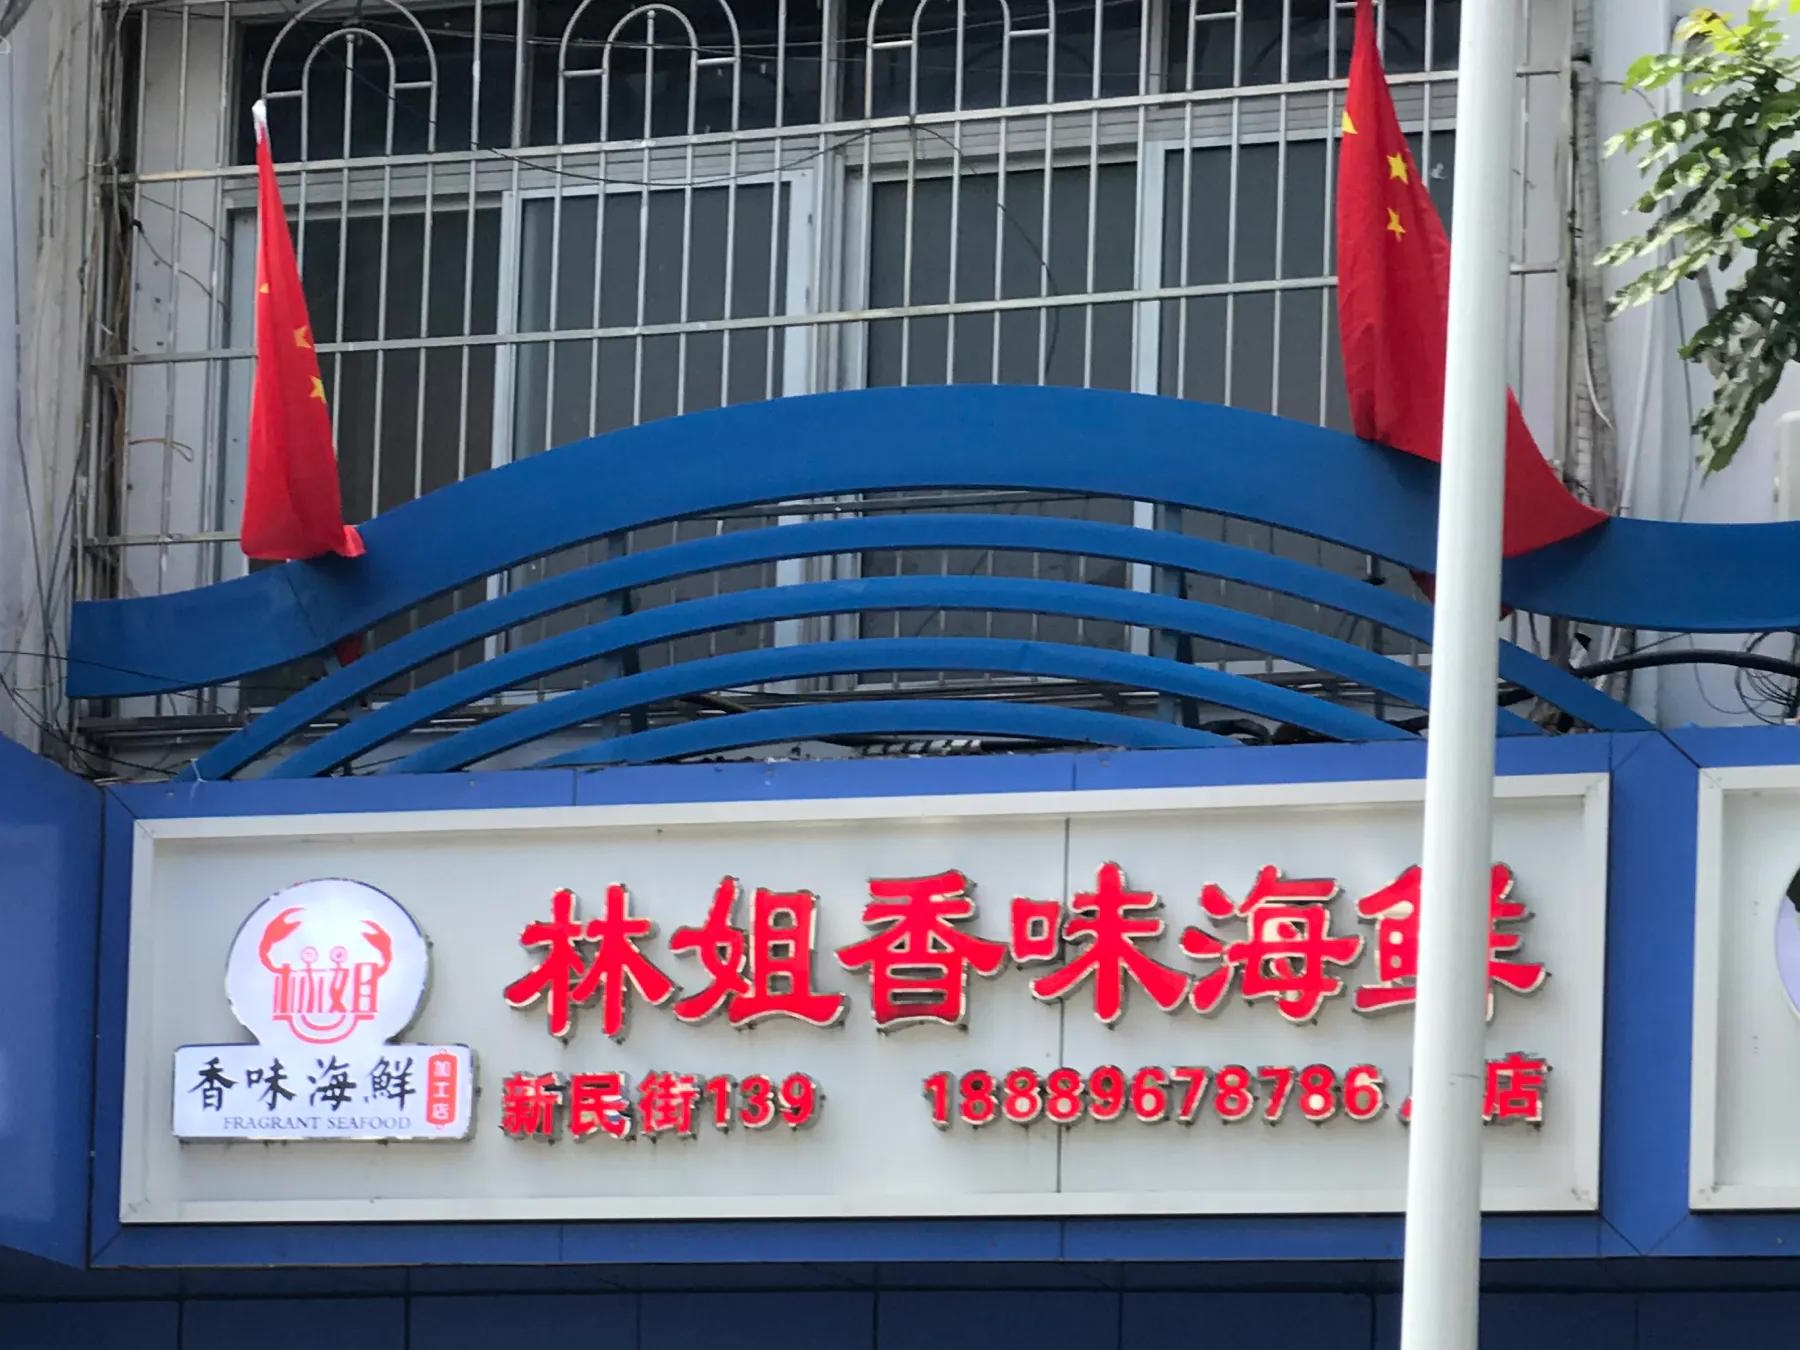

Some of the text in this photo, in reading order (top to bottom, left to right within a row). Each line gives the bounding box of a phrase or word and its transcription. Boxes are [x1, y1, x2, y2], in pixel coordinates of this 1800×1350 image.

[224, 1116, 412, 1130] FRAGRANT SEAFOOD
[502, 1071, 817, 1140] 新民街139
[923, 1064, 1384, 1128] 18889678786
